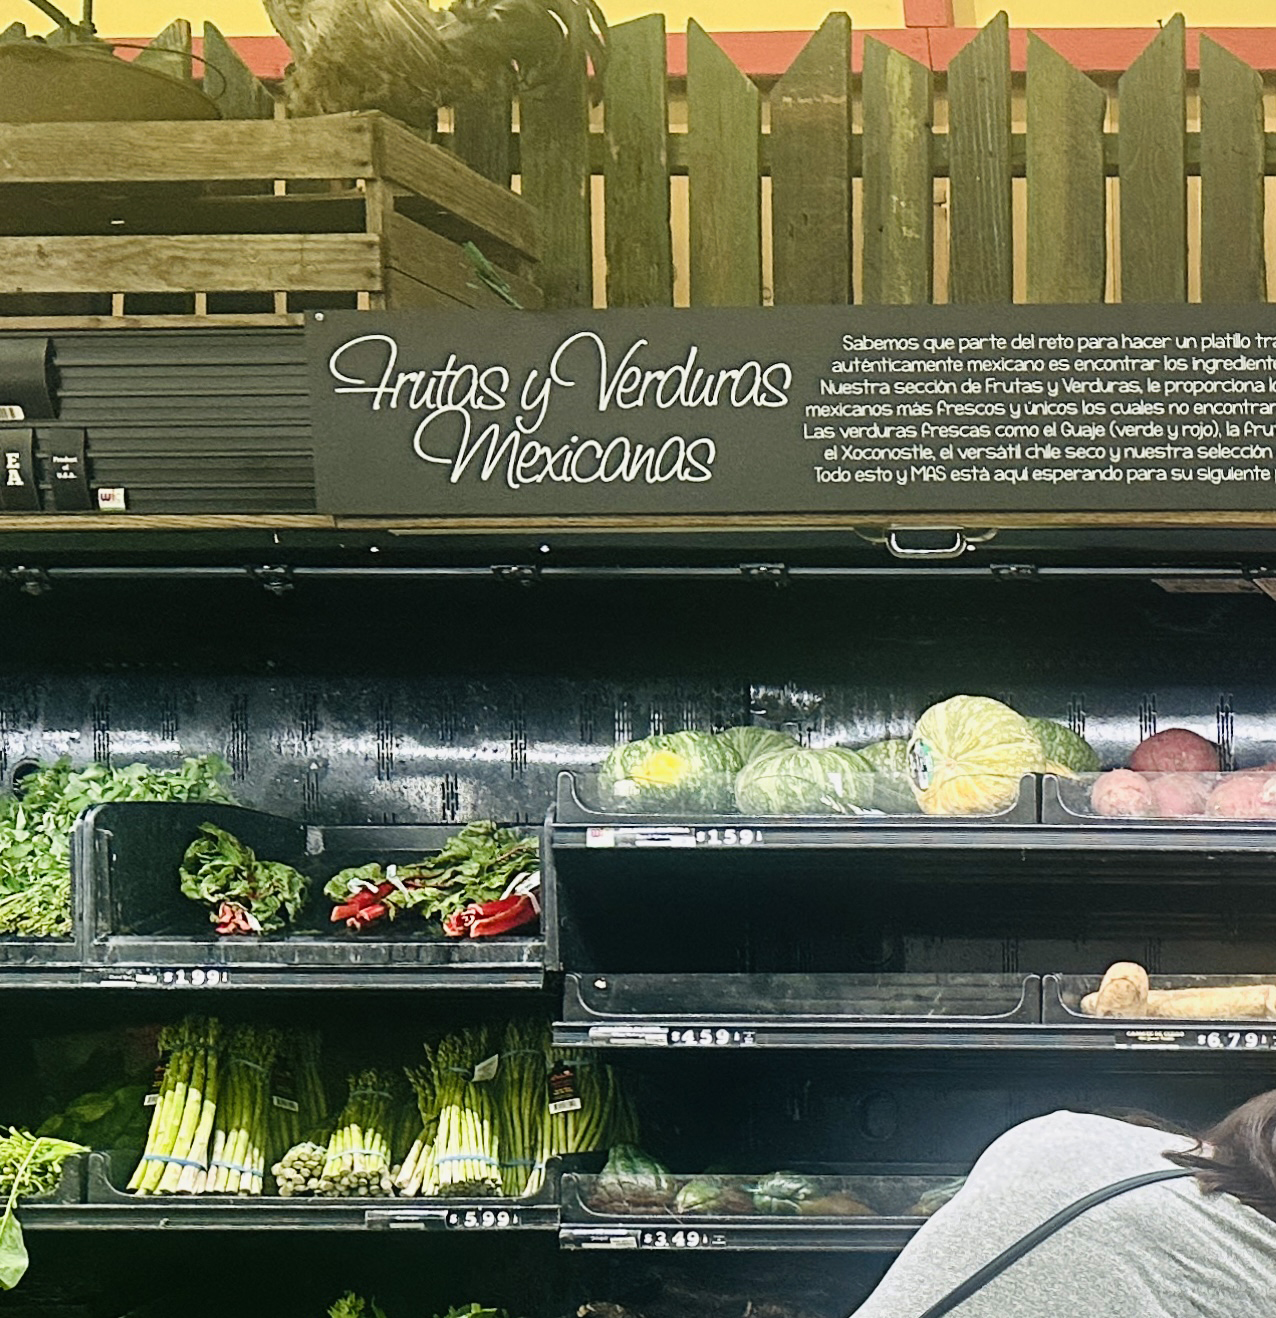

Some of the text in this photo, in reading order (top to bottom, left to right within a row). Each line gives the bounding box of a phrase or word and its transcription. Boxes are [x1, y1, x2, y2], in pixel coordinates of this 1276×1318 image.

[842, 334, 920, 351] Sabemos
[922, 337, 956, 354] que
[958, 333, 1007, 354] parte
[1010, 333, 1035, 350] del
[1038, 333, 1074, 350] reto
[1077, 336, 1119, 353] para
[1121, 333, 1172, 350] hacer
[1175, 336, 1198, 350] un
[1200, 332, 1251, 353] platillo
[966, 356, 1045, 373] mexicano
[1048, 358, 1071, 372] es
[1073, 355, 1161, 372] encontrar
[1163, 354, 1189, 372] los
[328, 330, 793, 434] Frutas y Verduras
[820, 378, 891, 395] Nuestra
[960, 377, 982, 394] de
[985, 377, 1044, 394] Frutas
[1047, 381, 1059, 398] y
[1147, 377, 1161, 393] le
[1164, 377, 1266, 397] proporciona
[805, 402, 894, 418] mexicanos
[936, 399, 1006, 416] frescos
[1009, 403, 1021, 420] y
[1081, 399, 1107, 416] los
[1109, 399, 1166, 416] cuales
[1168, 402, 1190, 416] no
[803, 423, 836, 440] Las
[838, 422, 918, 439] verduras
[921, 421, 992, 438] frescas
[994, 424, 1040, 438] como
[1042, 421, 1057, 438] el
[1060, 420, 1106, 441] Guaje
[1167, 424, 1179, 441] y
[1225, 420, 1241, 437] la
[413, 407, 717, 490] Mexicanas
[823, 444, 838, 461] el
[939, 443, 954, 460] el
[1024, 443, 1062, 460] chile
[1064, 446, 1106, 460] seco
[1109, 446, 1121, 463] y
[1123, 443, 1194, 460] nuestra
[813, 466, 852, 483] Todo
[854, 466, 893, 483] esto
[895, 469, 908, 486] y
[1031, 464, 1124, 485] esperando
[1126, 468, 1168, 485] para
[1170, 468, 1194, 481] su
[1196, 465, 1271, 485] siguiente
